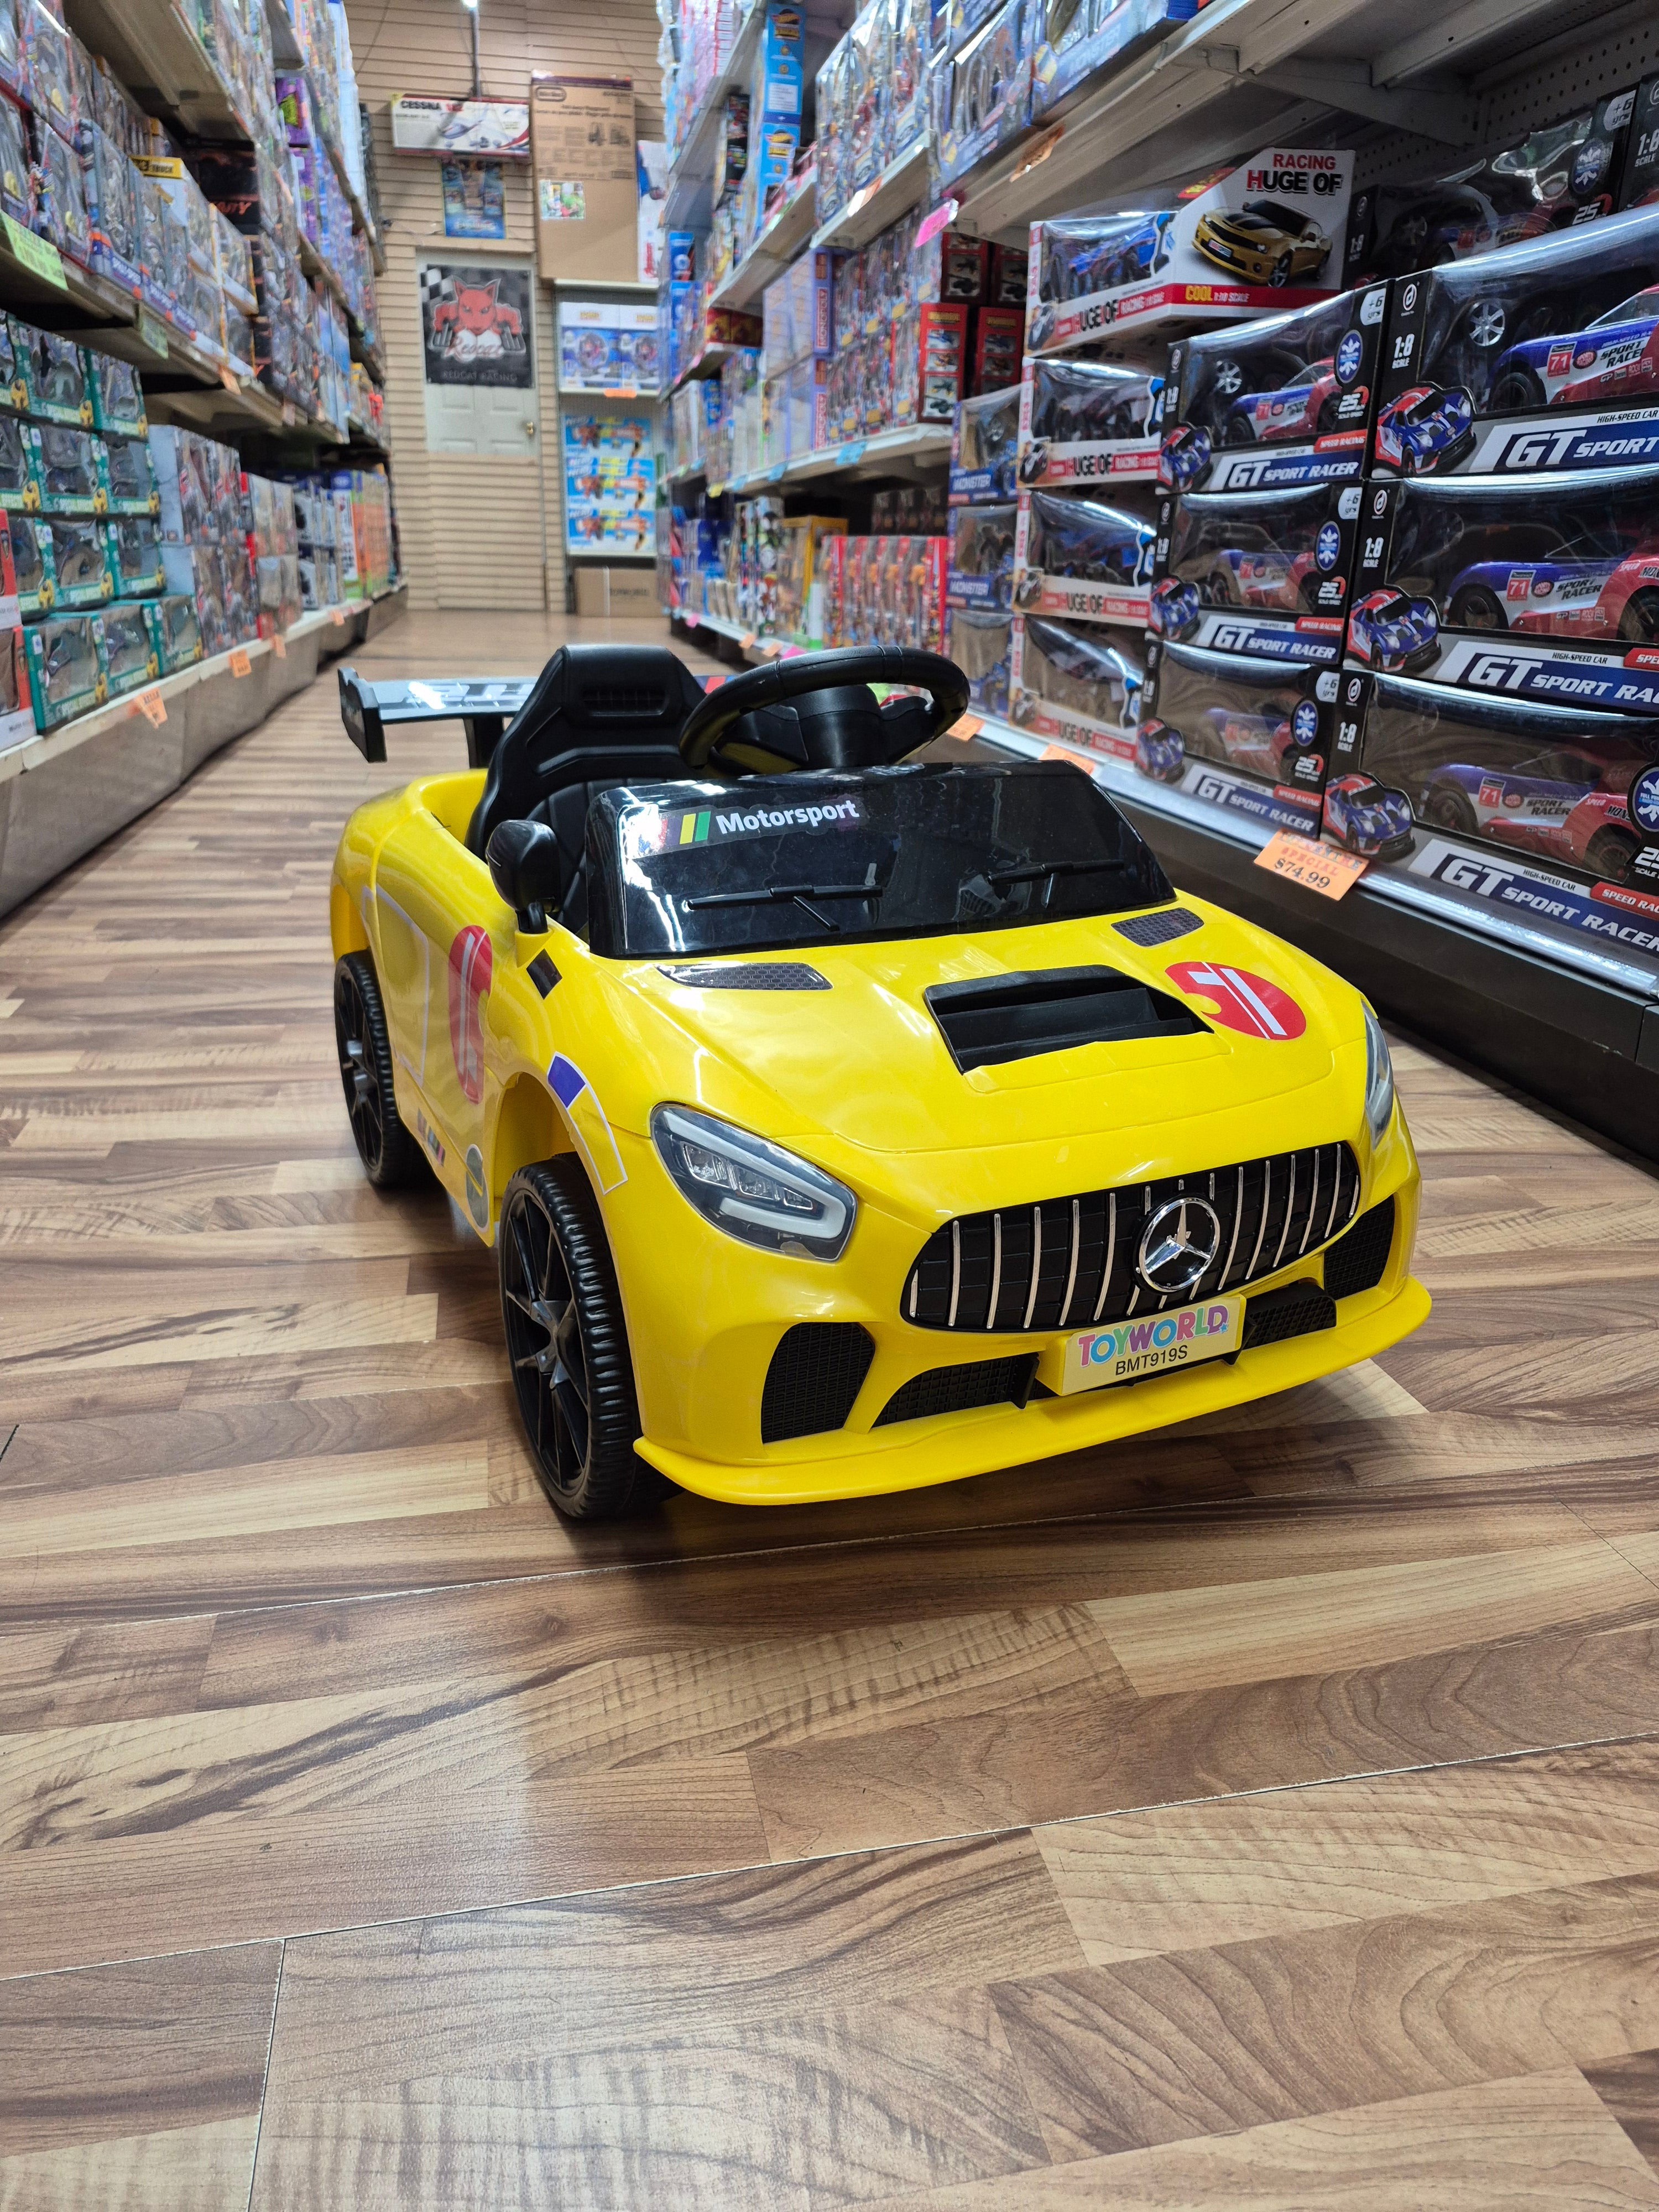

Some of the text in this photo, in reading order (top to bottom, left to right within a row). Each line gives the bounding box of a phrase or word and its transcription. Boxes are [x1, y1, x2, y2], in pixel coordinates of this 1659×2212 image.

[401, 100, 441, 110] CESSNA
[1273, 154, 1336, 170] RACING
[1246, 169, 1344, 195] HUGE OF
[1185, 285, 1213, 301] COOL
[818, 289, 828, 347] MONOPOLY
[1394, 333, 1415, 359] 1:8
[1600, 340, 1645, 361] SPORT
[1550, 355, 1568, 371] 71
[1338, 393, 1361, 413] 25
[1597, 409, 1659, 424] HIGH-SPEED CAR
[1505, 429, 1659, 468] GT SPORT
[1228, 460, 1360, 489] GT SPORT RACER
[1365, 537, 1384, 558] 1:8
[1318, 581, 1339, 598] 25
[1509, 581, 1526, 596] 71
[1556, 578, 1595, 593] SPORT
[1561, 584, 1603, 600] RACER
[1214, 625, 1337, 660] GT SPORT RACER
[1552, 651, 1608, 664] HIGH-SPEED CAR
[1468, 652, 1543, 690] GT
[1530, 674, 1614, 697] SPORT
[1339, 721, 1358, 743] 1:8
[1295, 755, 1317, 773] 25
[1198, 777, 1236, 804] GT
[1228, 794, 1269, 818] SPORT
[1269, 806, 1314, 832] RACER
[1481, 787, 1499, 803] 71
[1526, 798, 1567, 808] SPORT
[1585, 798, 1606, 807] SPEED
[715, 800, 860, 834] Motorsport
[1531, 806, 1571, 816] RACER
[1274, 856, 1331, 889] $74.99
[1280, 847, 1341, 877] SPECIAL
[1523, 868, 1576, 891] HIGH-SPEED CAR
[1441, 858, 1659, 952] GT SPORT RACER
[1602, 889, 1636, 906] SPEED
[1078, 1304, 1229, 1368] TOYWORLD
[1115, 1344, 1188, 1376] BMT919S
